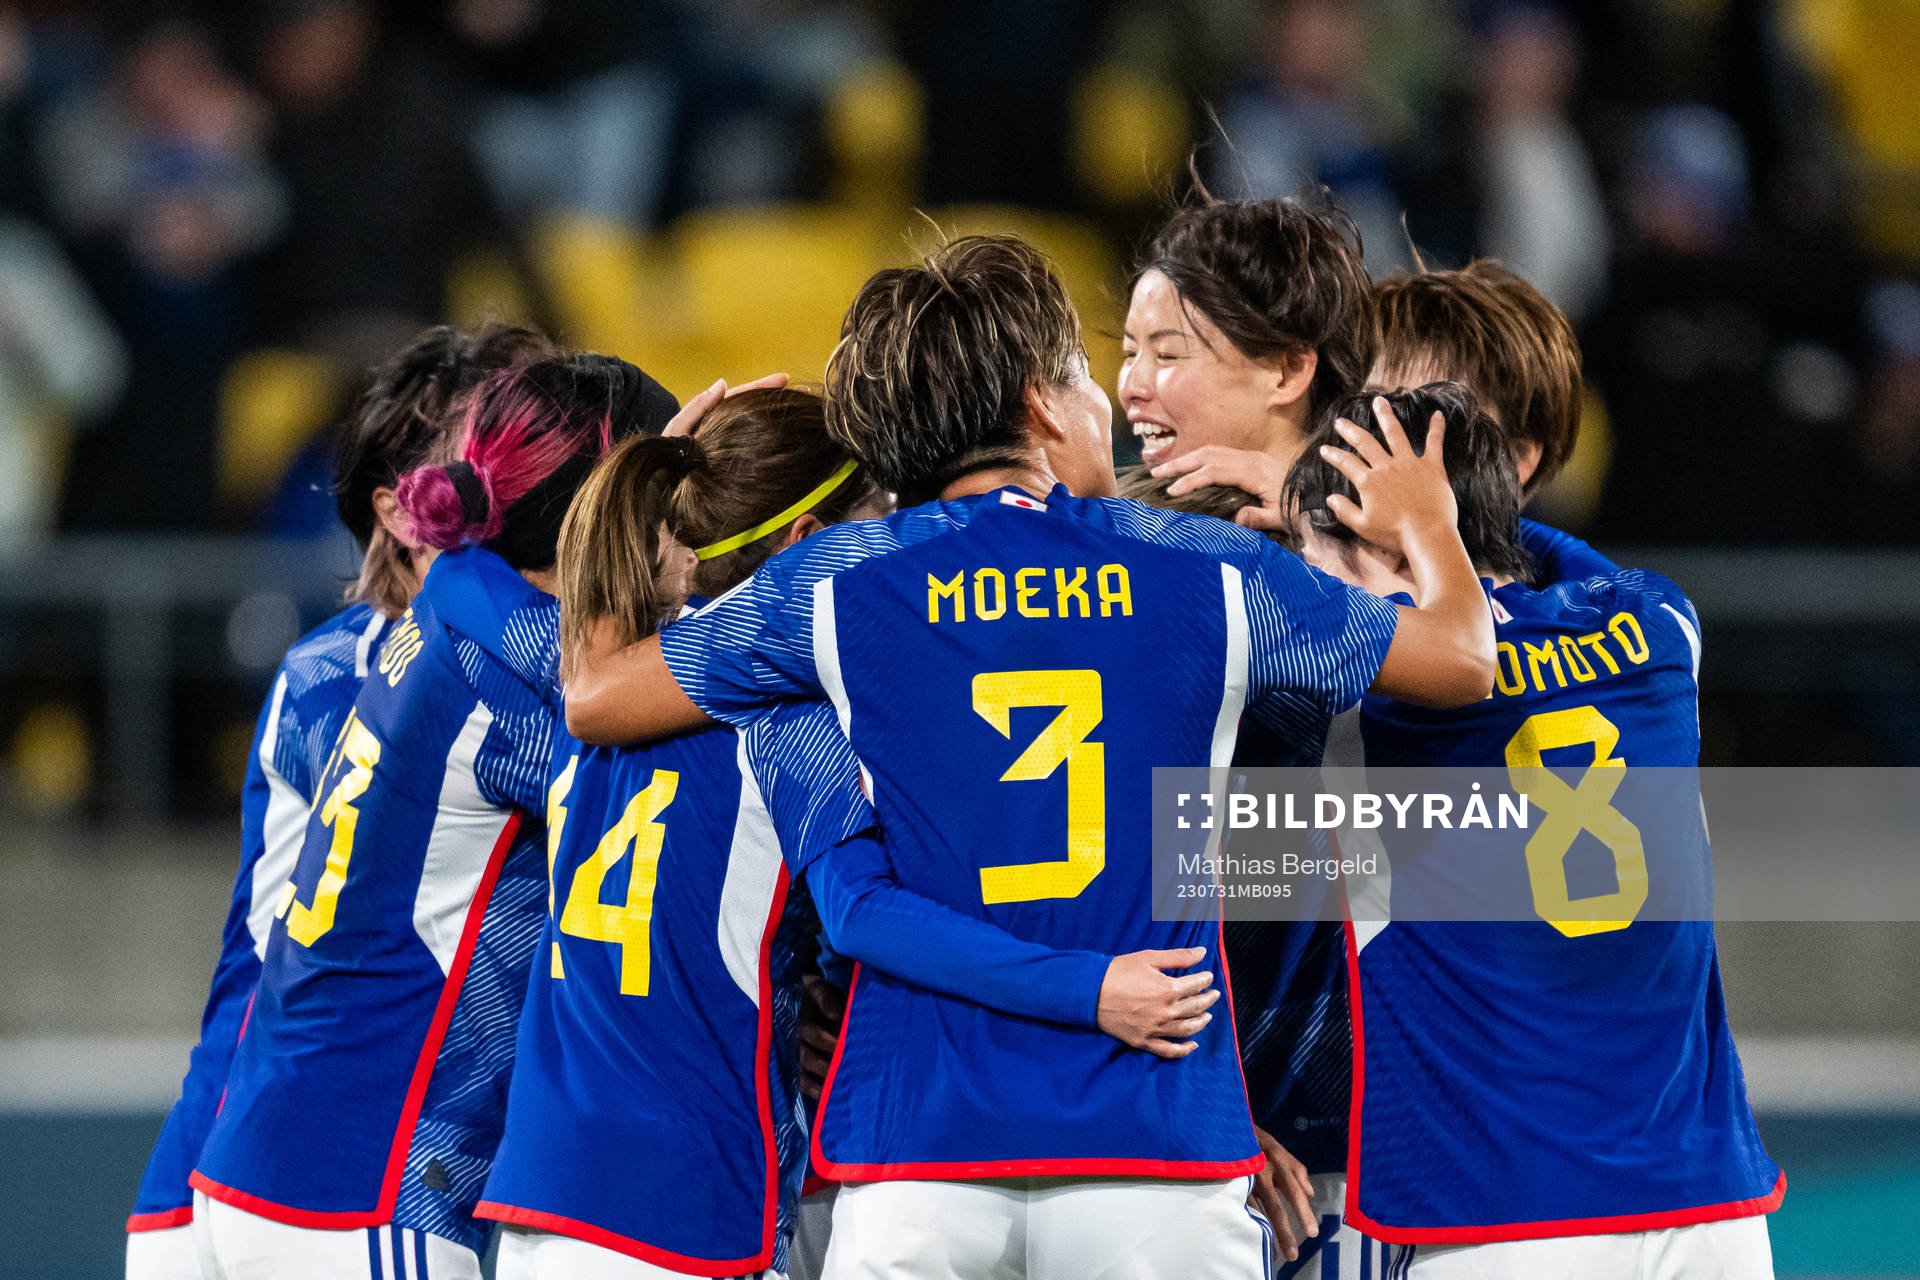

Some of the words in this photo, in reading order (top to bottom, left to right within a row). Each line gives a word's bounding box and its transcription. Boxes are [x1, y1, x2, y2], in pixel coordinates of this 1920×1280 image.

[927, 563, 1134, 624] MOEKA
[1486, 611, 1650, 699] OMOTO
[971, 668, 1106, 905] 3
[1504, 704, 1650, 938] 8
